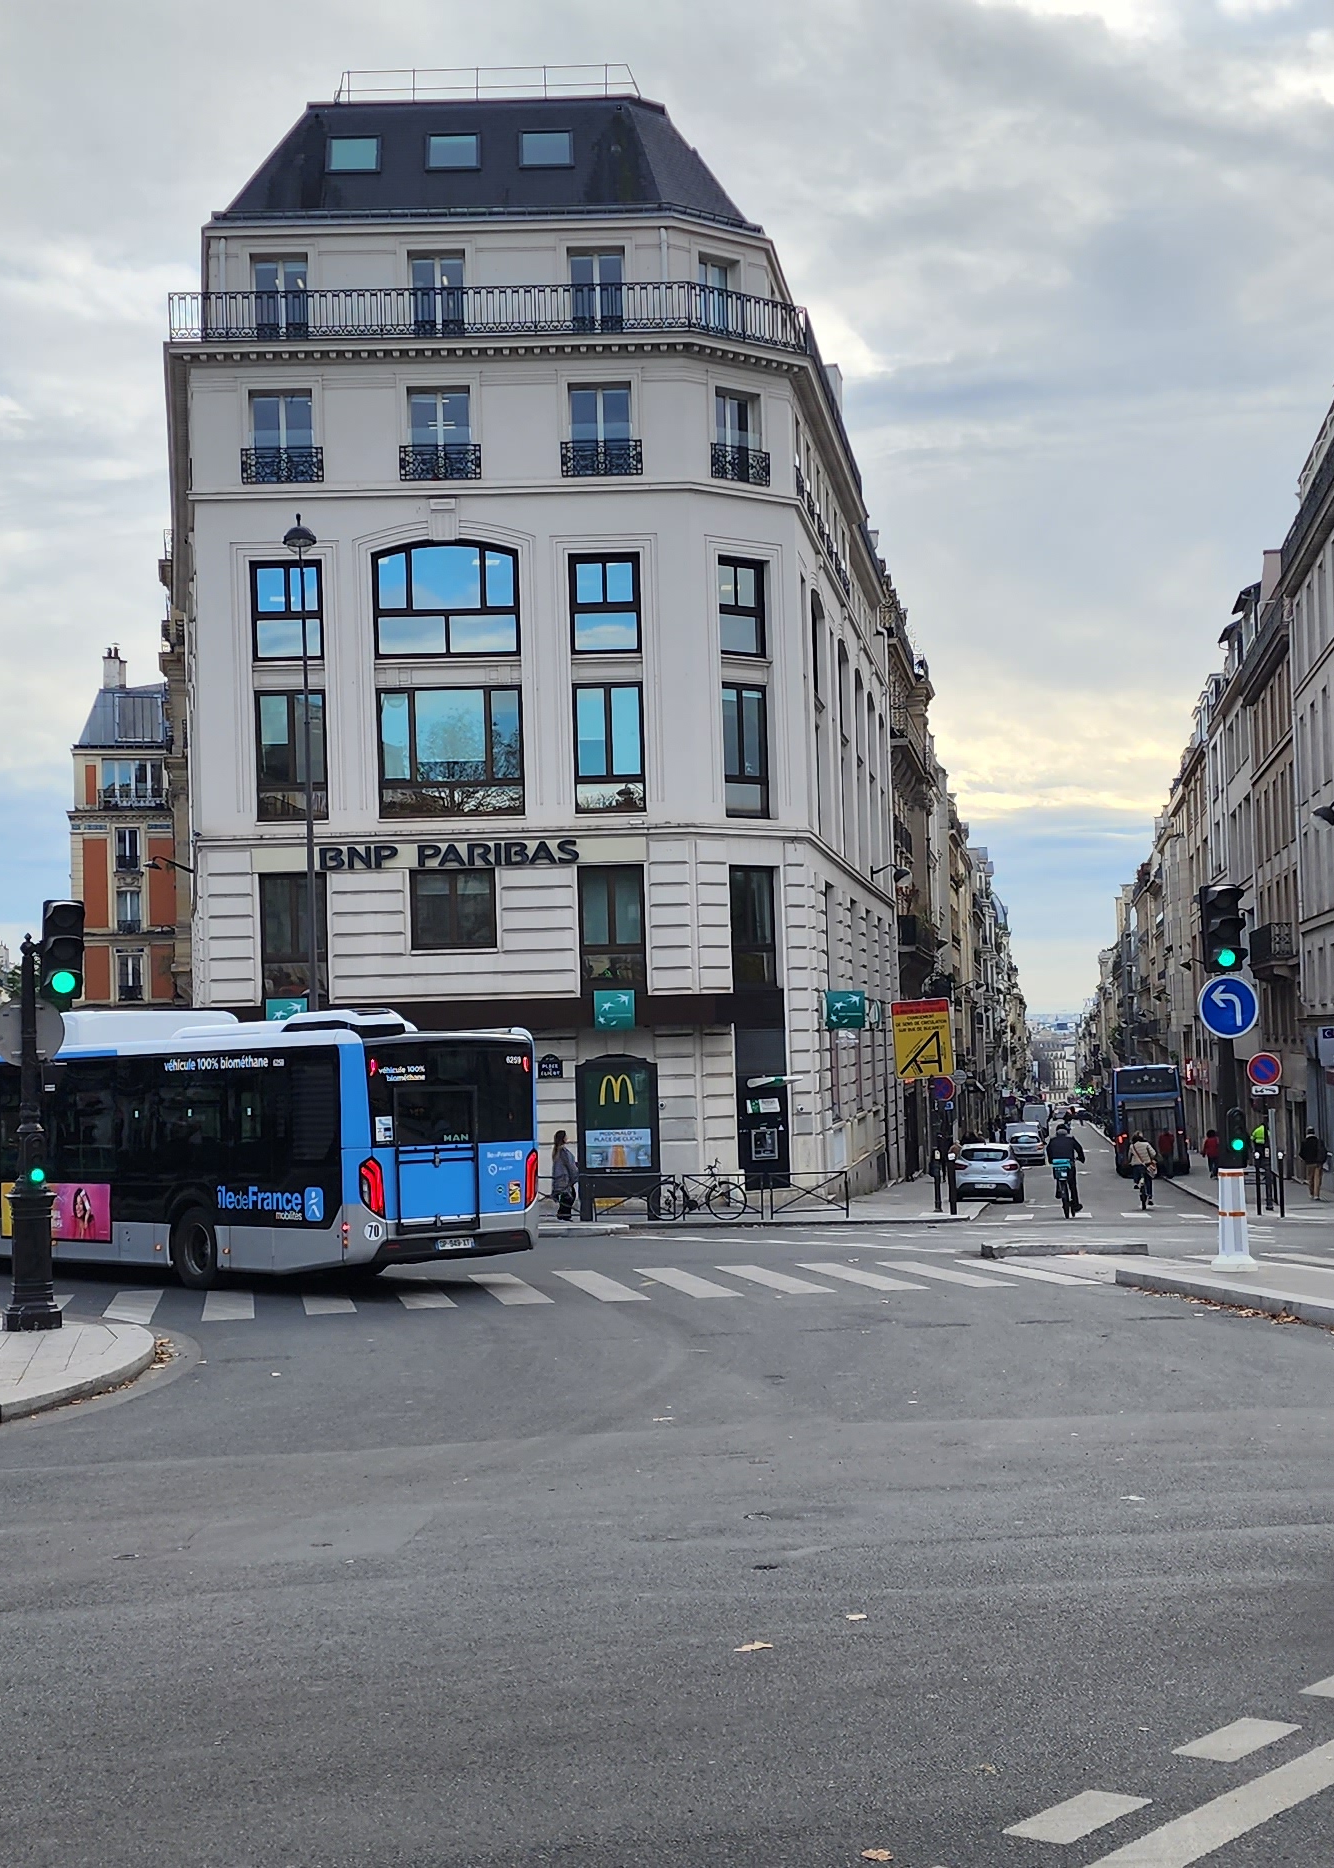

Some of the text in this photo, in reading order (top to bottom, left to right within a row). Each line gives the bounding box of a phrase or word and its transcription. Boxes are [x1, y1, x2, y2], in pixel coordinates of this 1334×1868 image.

[319, 839, 580, 870] BNP PARIBAS
[164, 1058, 196, 1071] véhicule
[197, 1057, 219, 1070] 100%
[220, 1055, 269, 1069] biométhane
[378, 1065, 426, 1075] véhicule 100%
[444, 1134, 469, 1142] MAN
[276, 1211, 303, 1221] mobilités
[368, 1224, 380, 1238] 70
